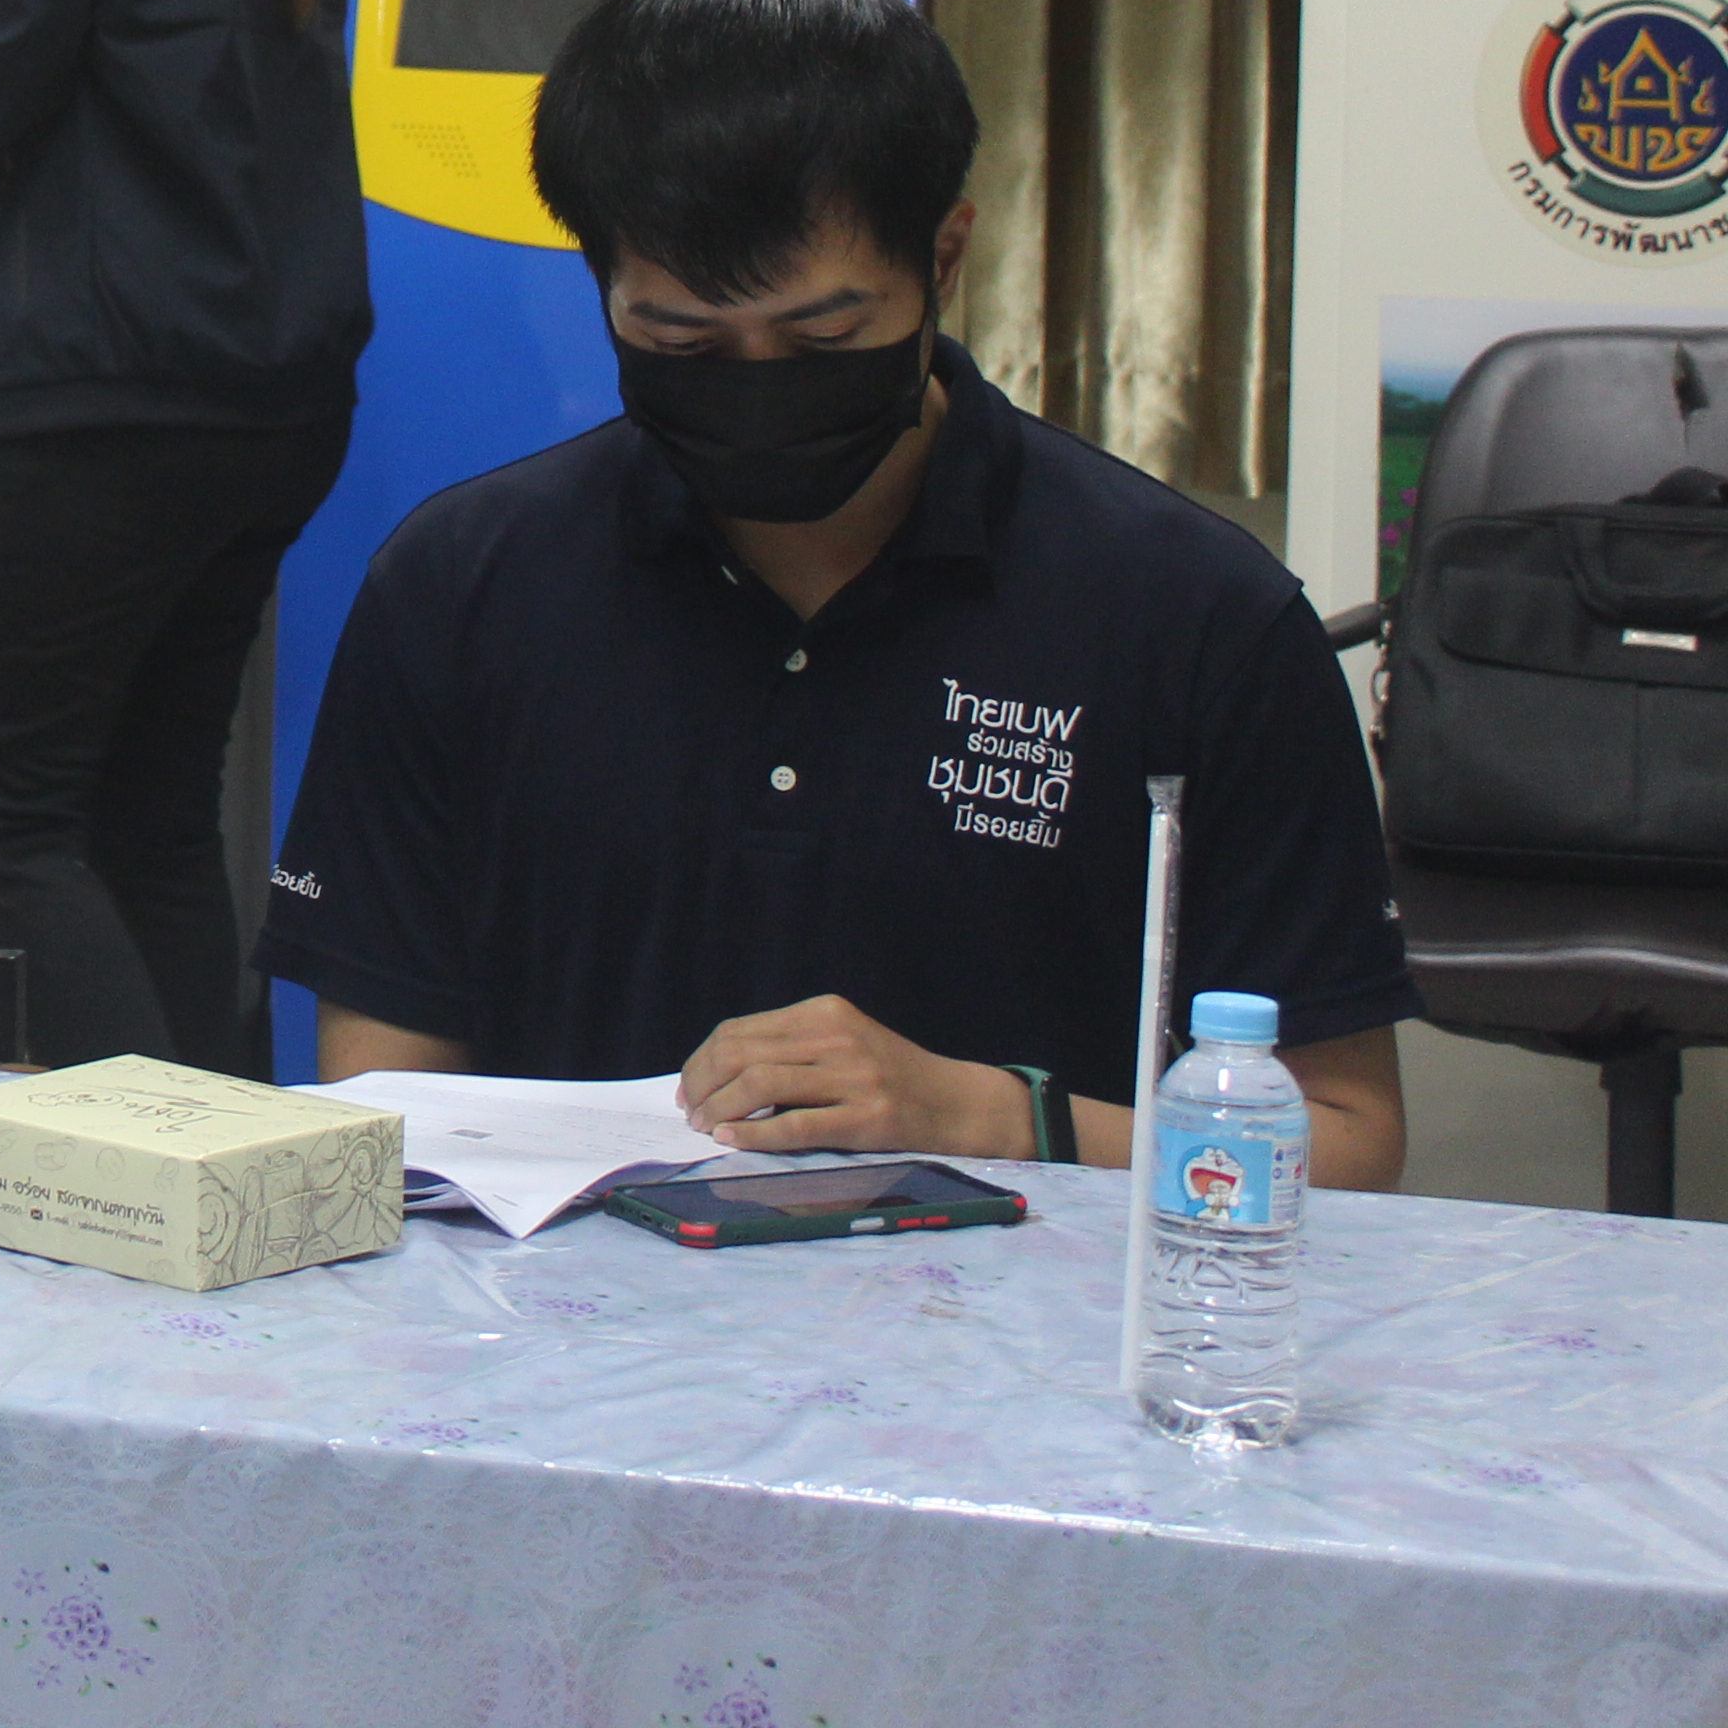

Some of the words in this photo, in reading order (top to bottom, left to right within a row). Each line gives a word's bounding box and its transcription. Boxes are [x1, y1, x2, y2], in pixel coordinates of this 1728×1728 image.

[942, 677, 1083, 742] ไทยเบฟ
[967, 728, 1074, 770] ร่วมสร้าง
[928, 756, 1073, 812] ชุมชนดี
[954, 802, 1061, 848] มีรอยยิ้ม
[13, 1176, 51, 1201] อร่อย
